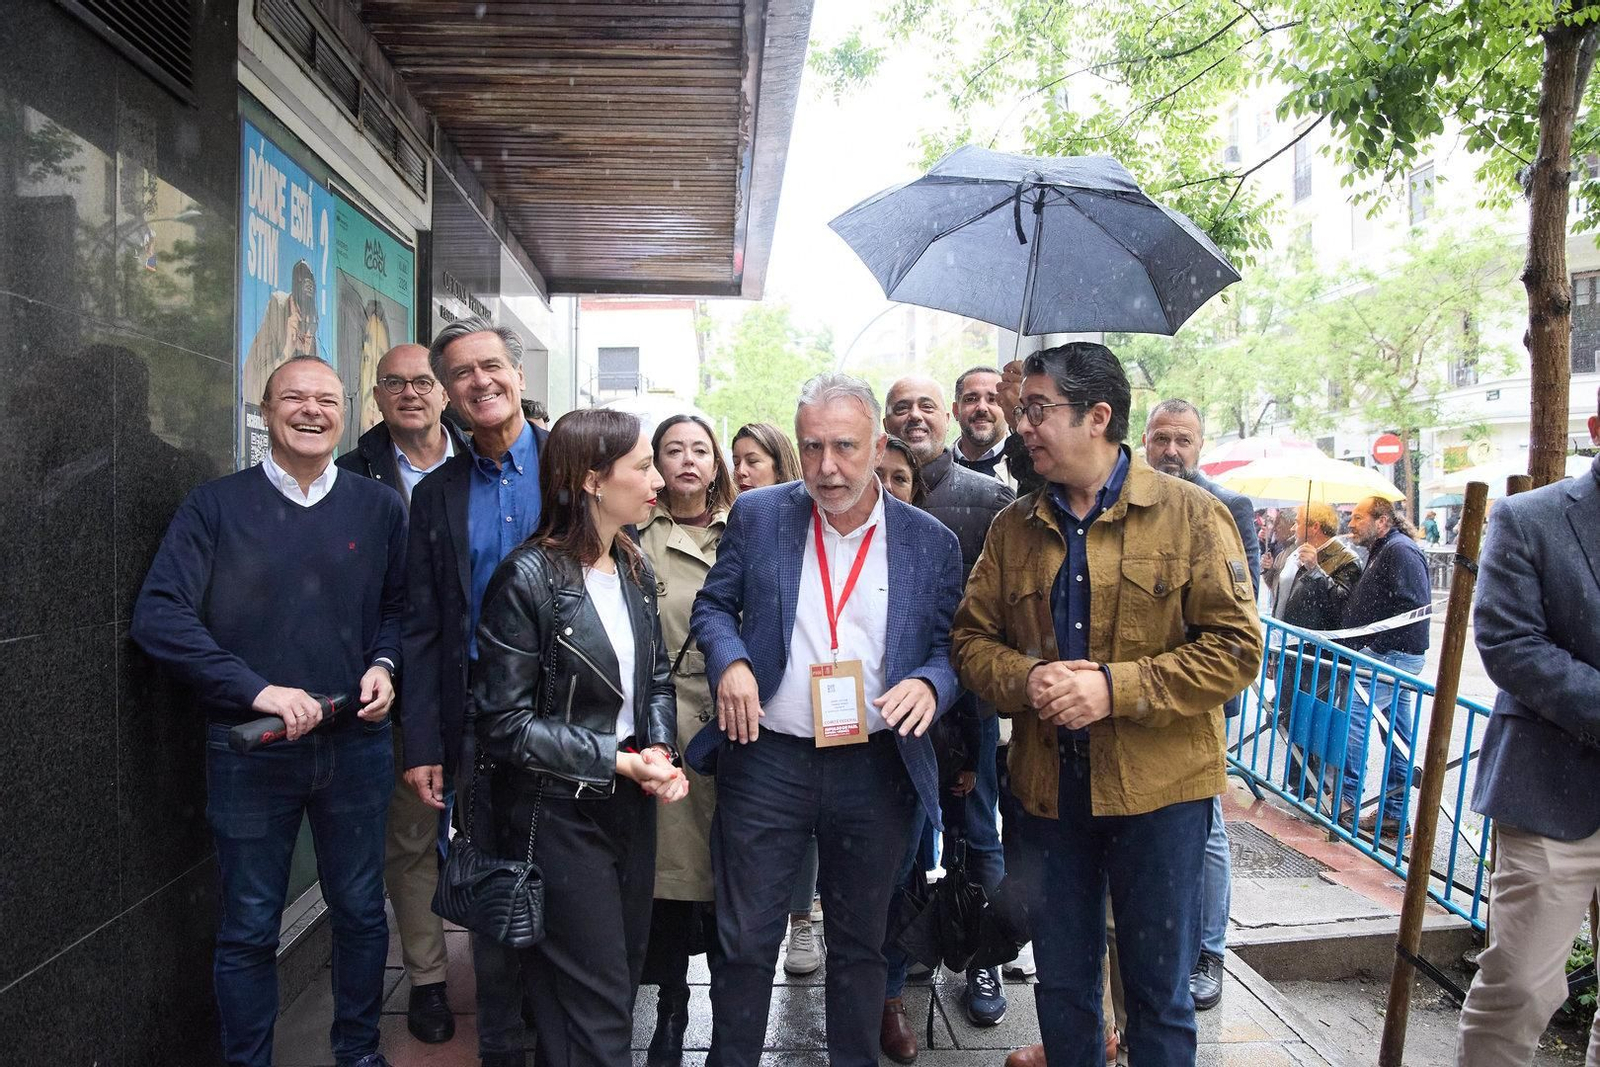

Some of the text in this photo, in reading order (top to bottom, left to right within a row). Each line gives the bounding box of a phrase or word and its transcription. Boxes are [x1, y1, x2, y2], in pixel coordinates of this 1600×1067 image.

[249, 138, 313, 250] DÓNDE ESTÁ
[364, 238, 384, 261] MAD
[364, 252, 388, 278] COOL
